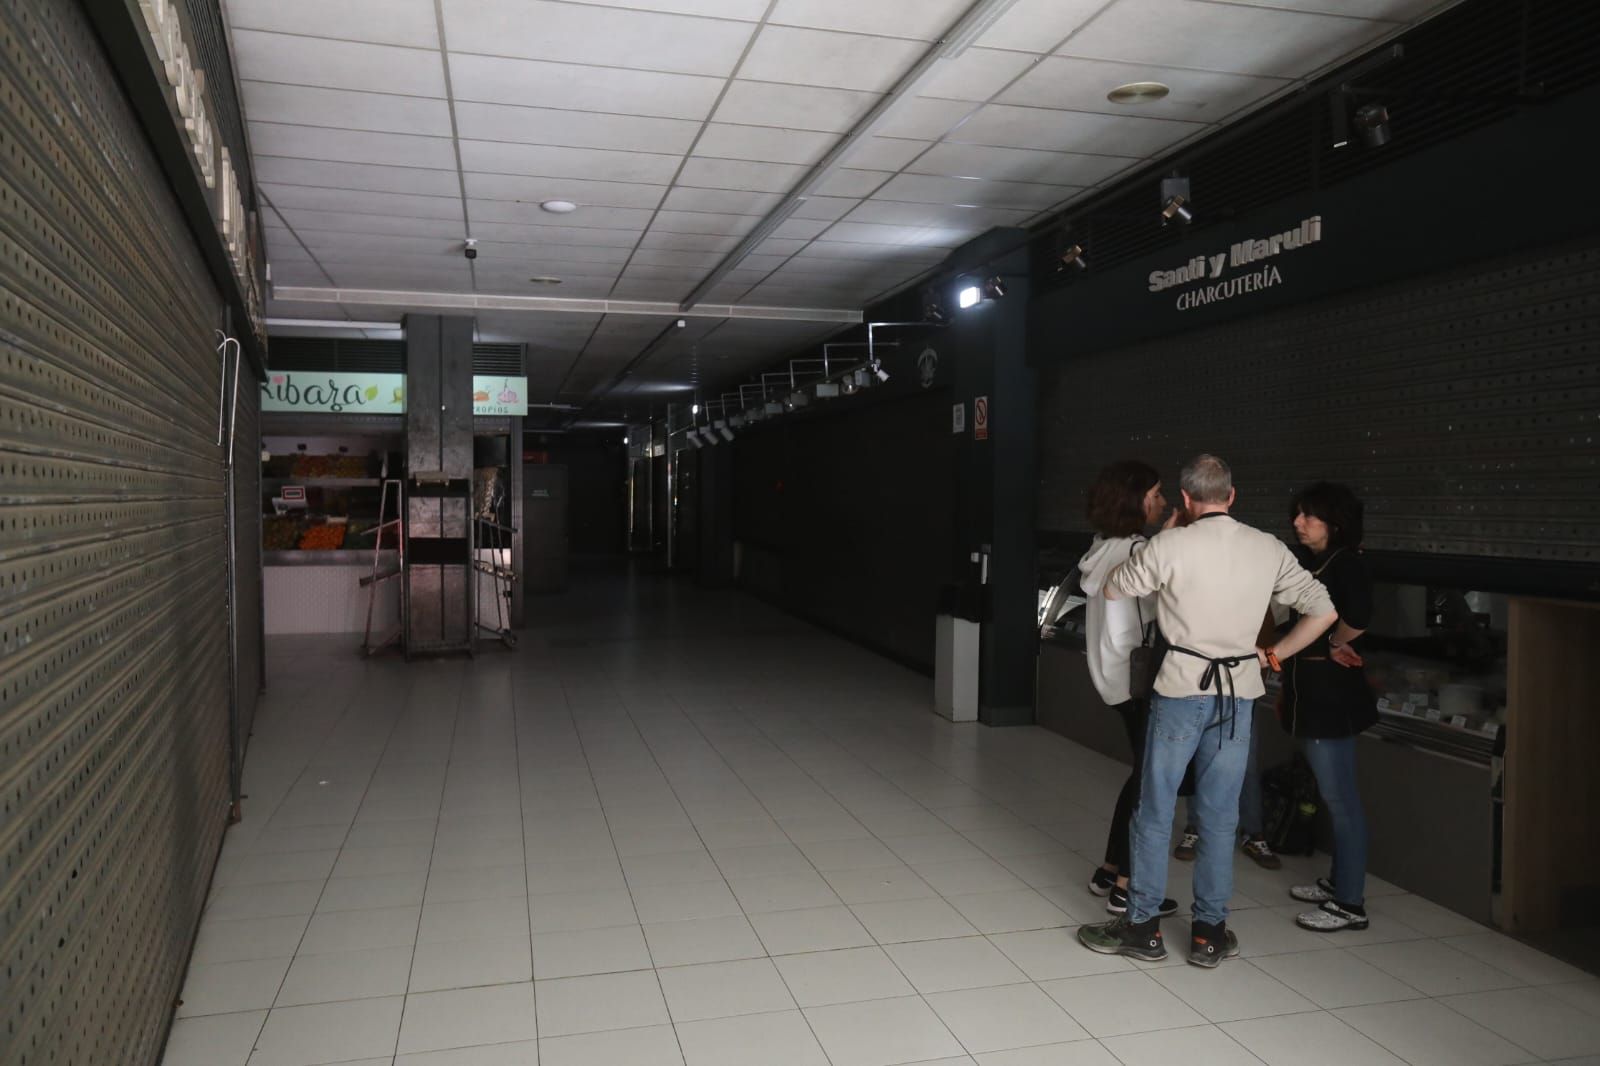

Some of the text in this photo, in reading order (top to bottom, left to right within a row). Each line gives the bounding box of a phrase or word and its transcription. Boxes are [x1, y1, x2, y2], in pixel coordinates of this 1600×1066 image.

[1148, 215, 1322, 292] Santi y Maruli
[1176, 264, 1283, 311] CHARCUTERÍA
[475, 406, 508, 414] ROPIOS
